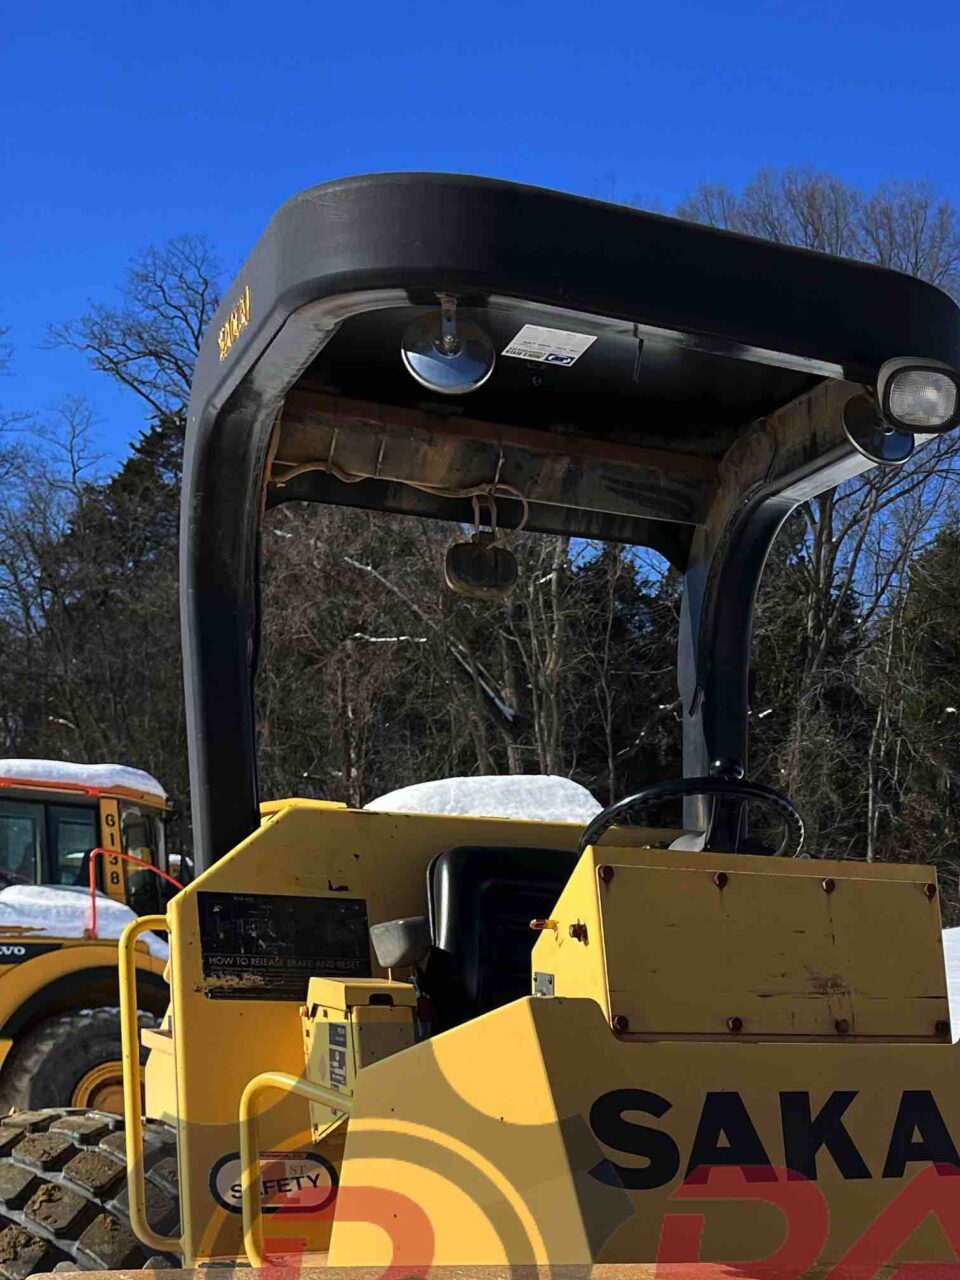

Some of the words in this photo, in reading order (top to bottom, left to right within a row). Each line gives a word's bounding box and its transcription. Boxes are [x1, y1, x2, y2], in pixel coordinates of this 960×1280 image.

[0, 946, 26, 955] VO
[208, 955, 234, 965] HOW
[236, 956, 249, 966] TO
[251, 957, 287, 967] RELEASE
[230, 1173, 320, 1199] SFETY
